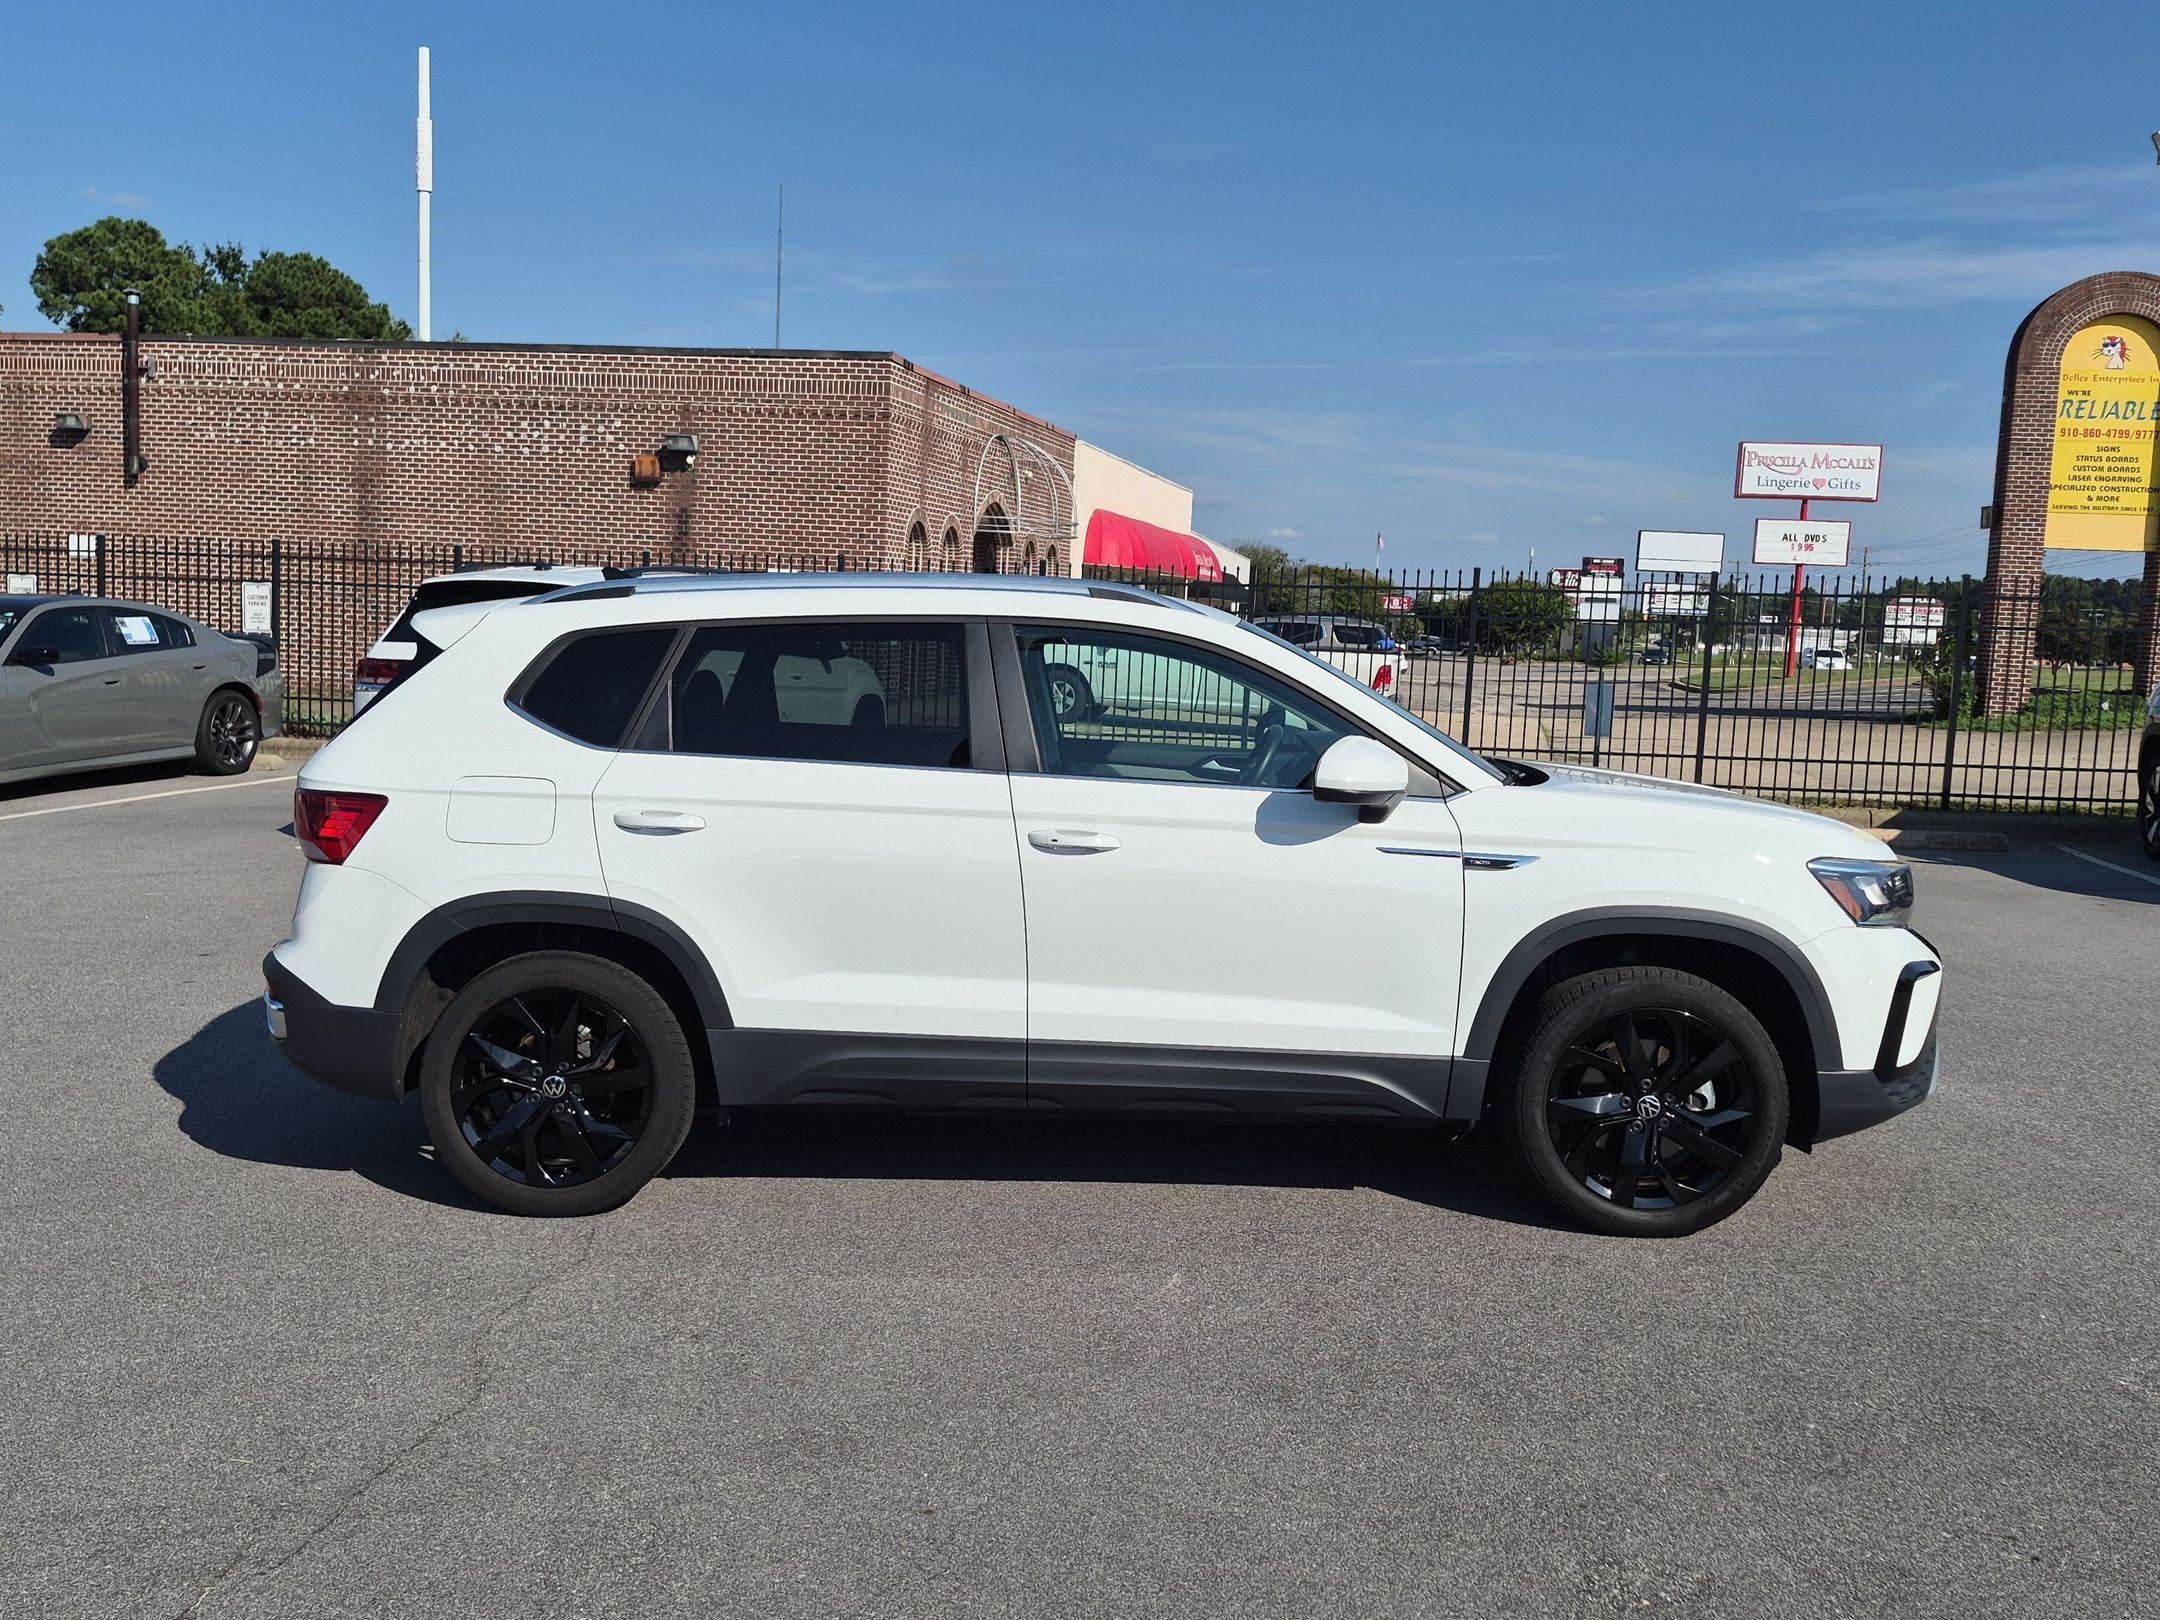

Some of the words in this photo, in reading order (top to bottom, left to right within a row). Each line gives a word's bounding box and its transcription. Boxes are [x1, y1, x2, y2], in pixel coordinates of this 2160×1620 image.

[2062, 373, 2089, 382] Belles
[2093, 374, 2146, 384] Enterprises
[2067, 389, 2092, 397] WE'RE
[2059, 398, 2160, 421] RELIABLE
[2096, 445, 2121, 453] SIGNS
[2105, 455, 2140, 464] BOARDS
[2107, 466, 2141, 474] BOARDS
[1756, 475, 1811, 491] Lingerie
[1827, 478, 1862, 490] Gifts
[2068, 474, 2092, 482] LASER
[2094, 475, 2143, 484] ENGRAVING
[2049, 484, 2097, 492] SPECIALIZED
[2099, 485, 2160, 494] CONSTRUCTION
[2096, 495, 2121, 503] MORE
[1782, 533, 1798, 542] ALL
